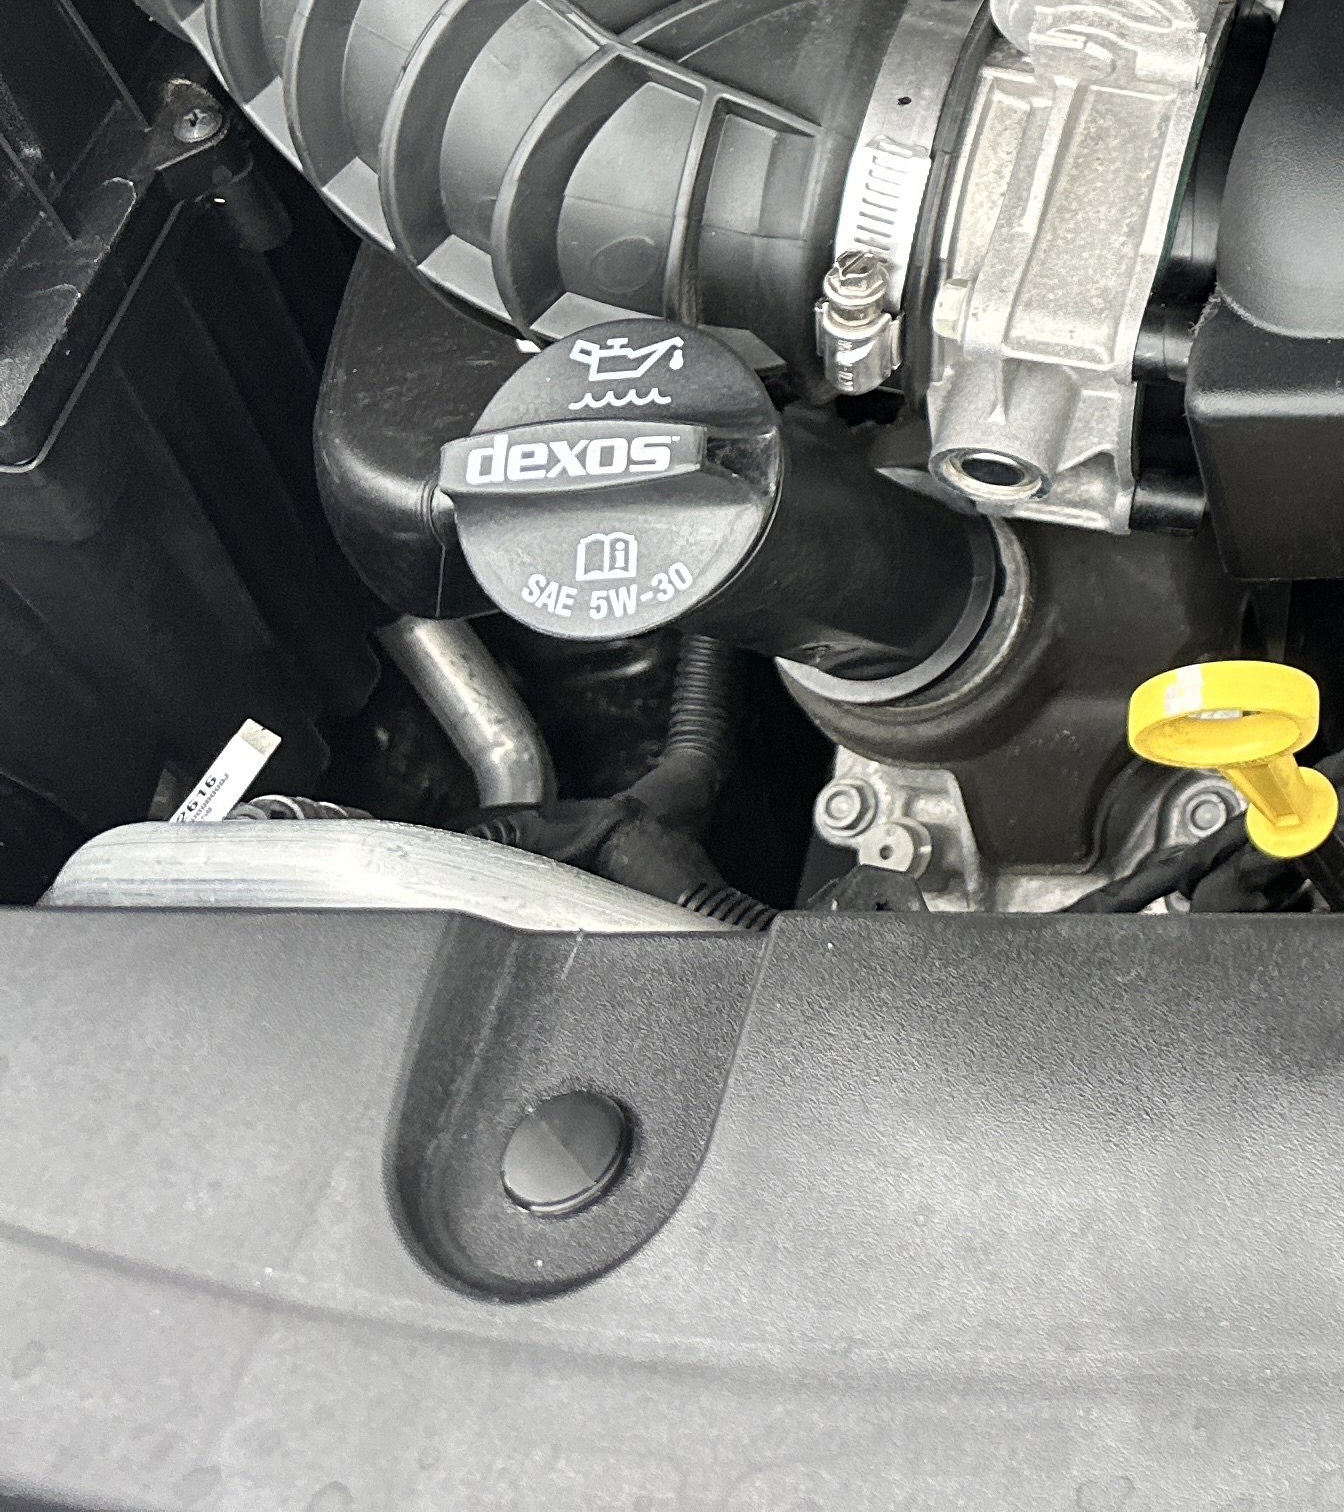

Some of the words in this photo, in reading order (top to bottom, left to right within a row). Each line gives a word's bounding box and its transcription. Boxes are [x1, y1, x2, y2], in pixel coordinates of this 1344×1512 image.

[465, 434, 674, 486] dexos
[521, 573, 575, 618] SAE
[589, 561, 694, 620] 5W-30
